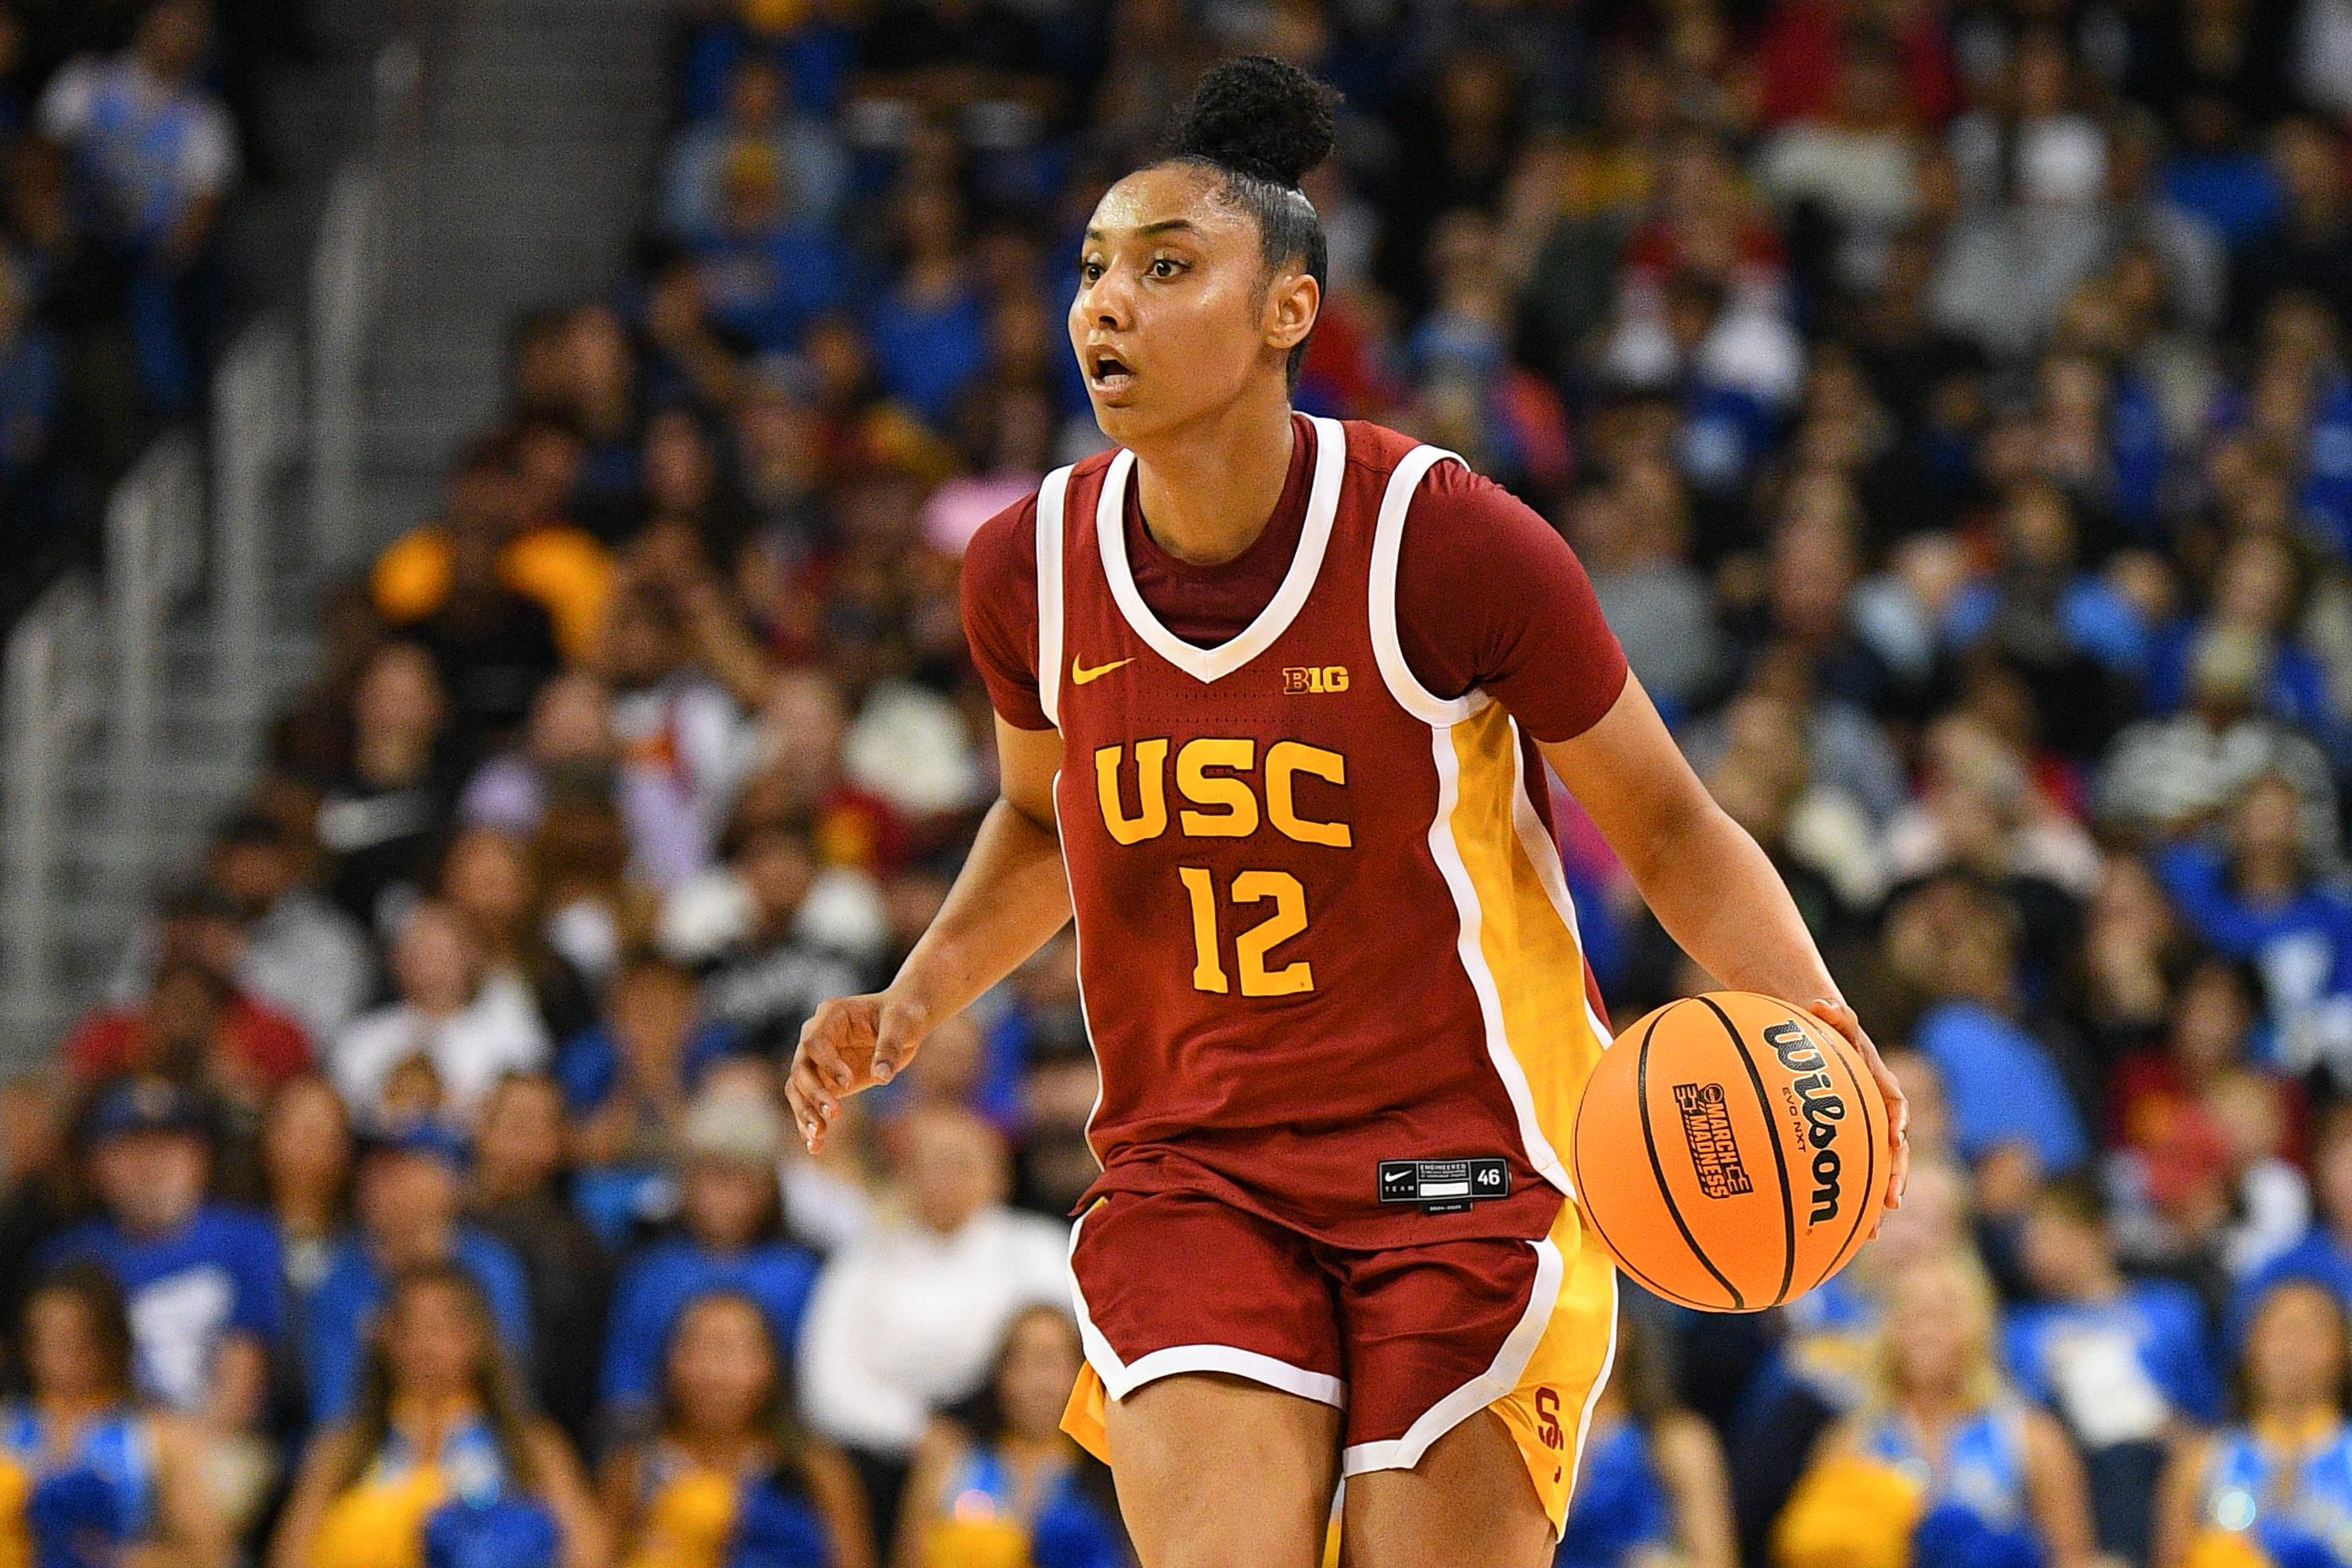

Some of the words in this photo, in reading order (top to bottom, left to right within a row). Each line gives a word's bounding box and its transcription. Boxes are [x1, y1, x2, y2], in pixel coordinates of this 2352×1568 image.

[1094, 738, 1353, 848] USC
[1178, 866, 1315, 997] 12
[1690, 1114, 1729, 1197] MADNESS
[1706, 1102, 1739, 1164] MARCH
[1763, 1020, 1845, 1227] Wilson
[1782, 1086, 1798, 1116] EVO
[1794, 1120, 1806, 1153] NXT
[1477, 1168, 1500, 1185] 46
